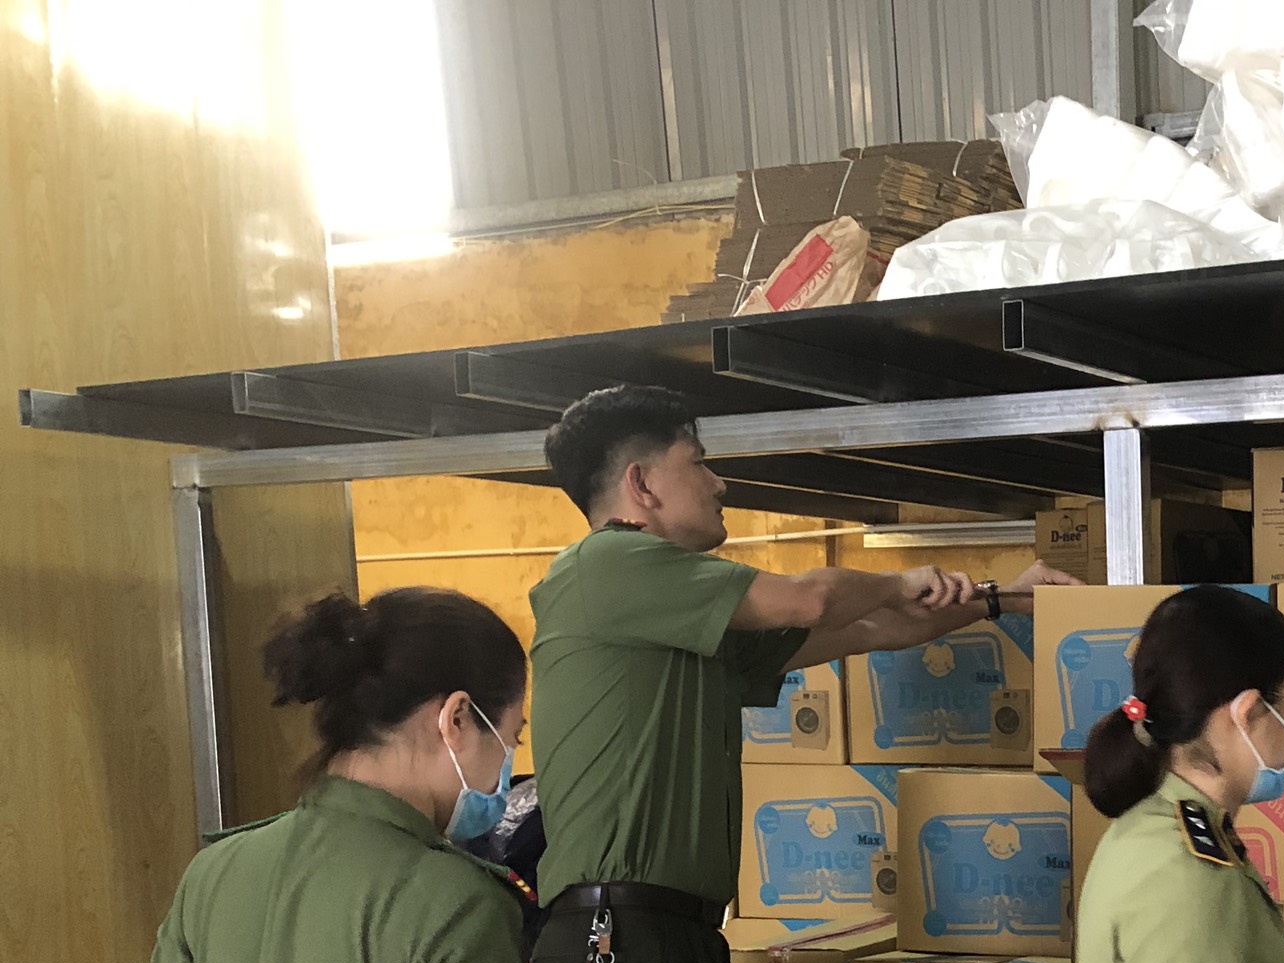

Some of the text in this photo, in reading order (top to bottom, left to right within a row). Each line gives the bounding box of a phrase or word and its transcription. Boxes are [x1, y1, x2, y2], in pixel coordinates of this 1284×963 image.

[783, 673, 799, 685] ax
[976, 672, 1000, 683] Max
[857, 834, 881, 846] Max
[782, 841, 866, 869] D-nee
[953, 862, 1055, 898] D-nee
